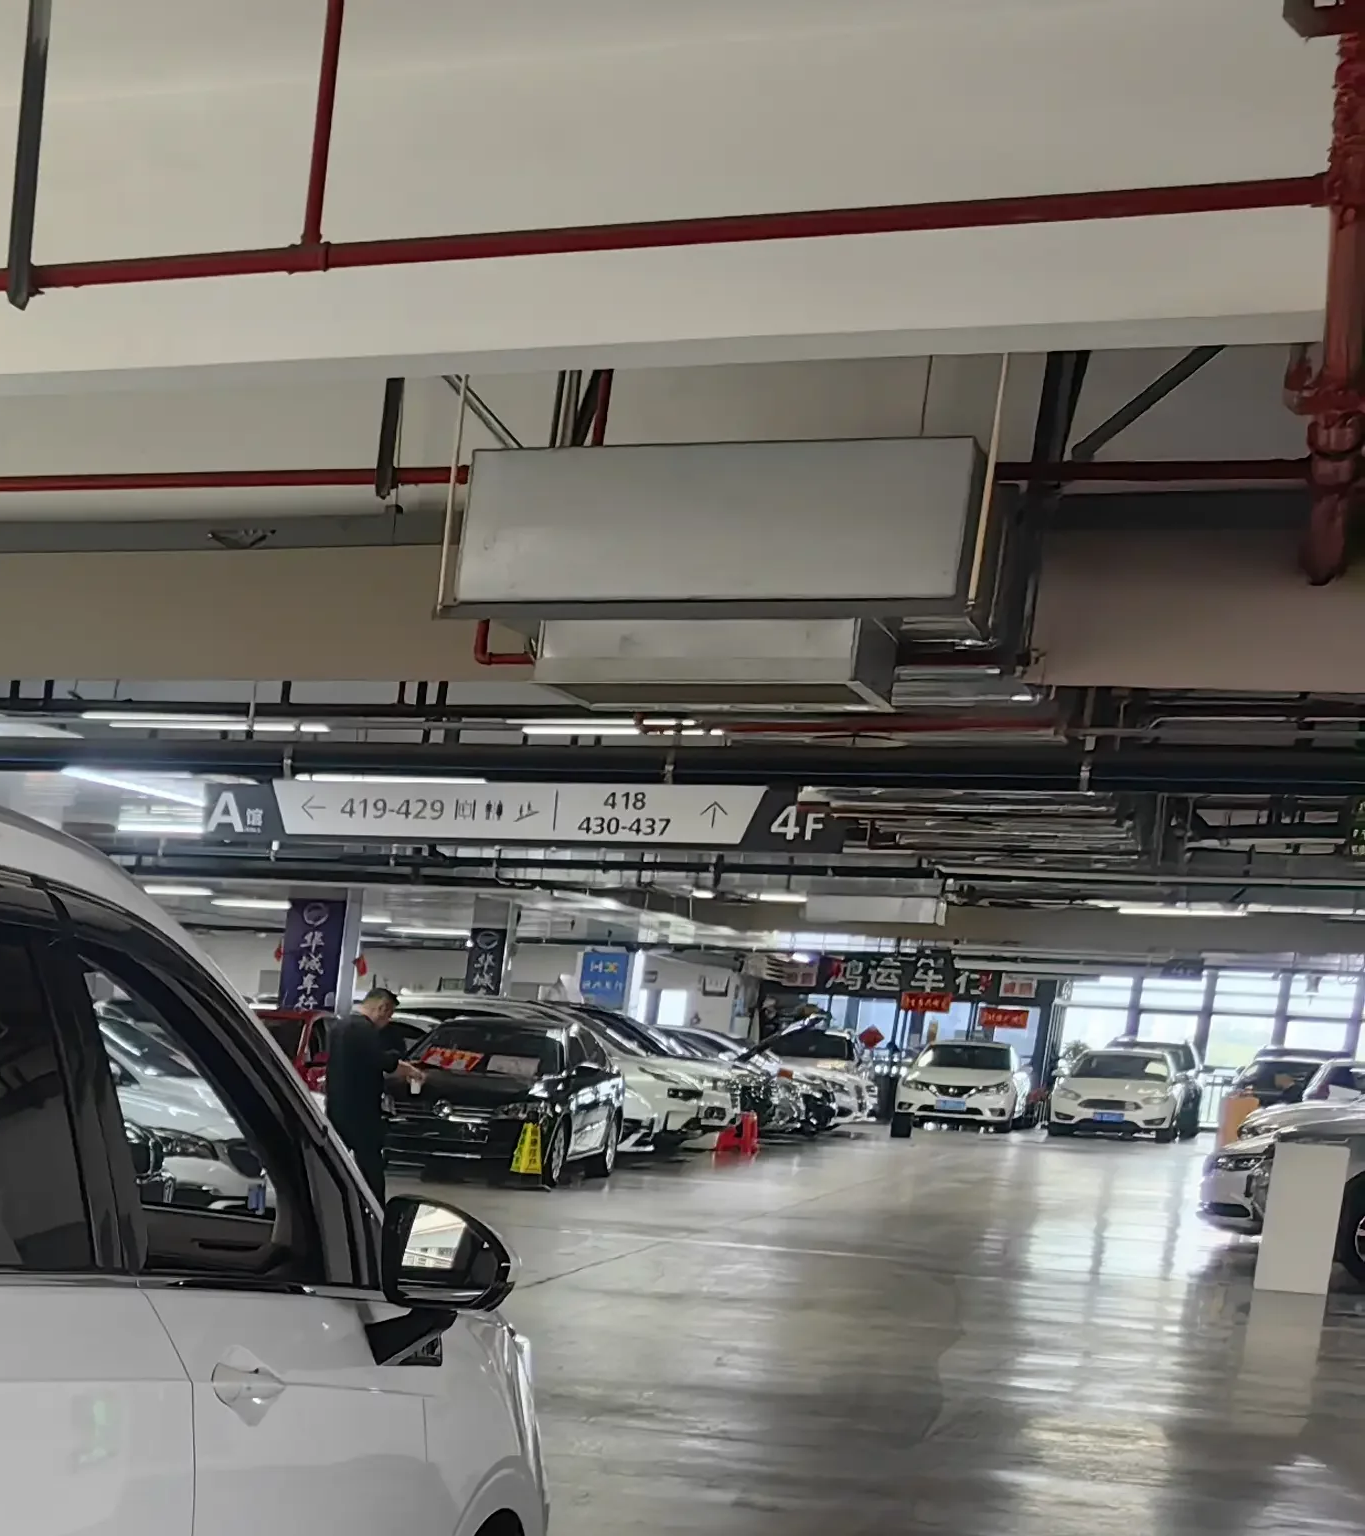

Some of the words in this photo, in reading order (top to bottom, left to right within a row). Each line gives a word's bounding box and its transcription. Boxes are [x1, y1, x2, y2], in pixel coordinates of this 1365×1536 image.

[339, 797, 446, 822] 419-429
[602, 791, 647, 811] 418
[577, 816, 672, 837] 430-437
[770, 804, 826, 842] 4F
